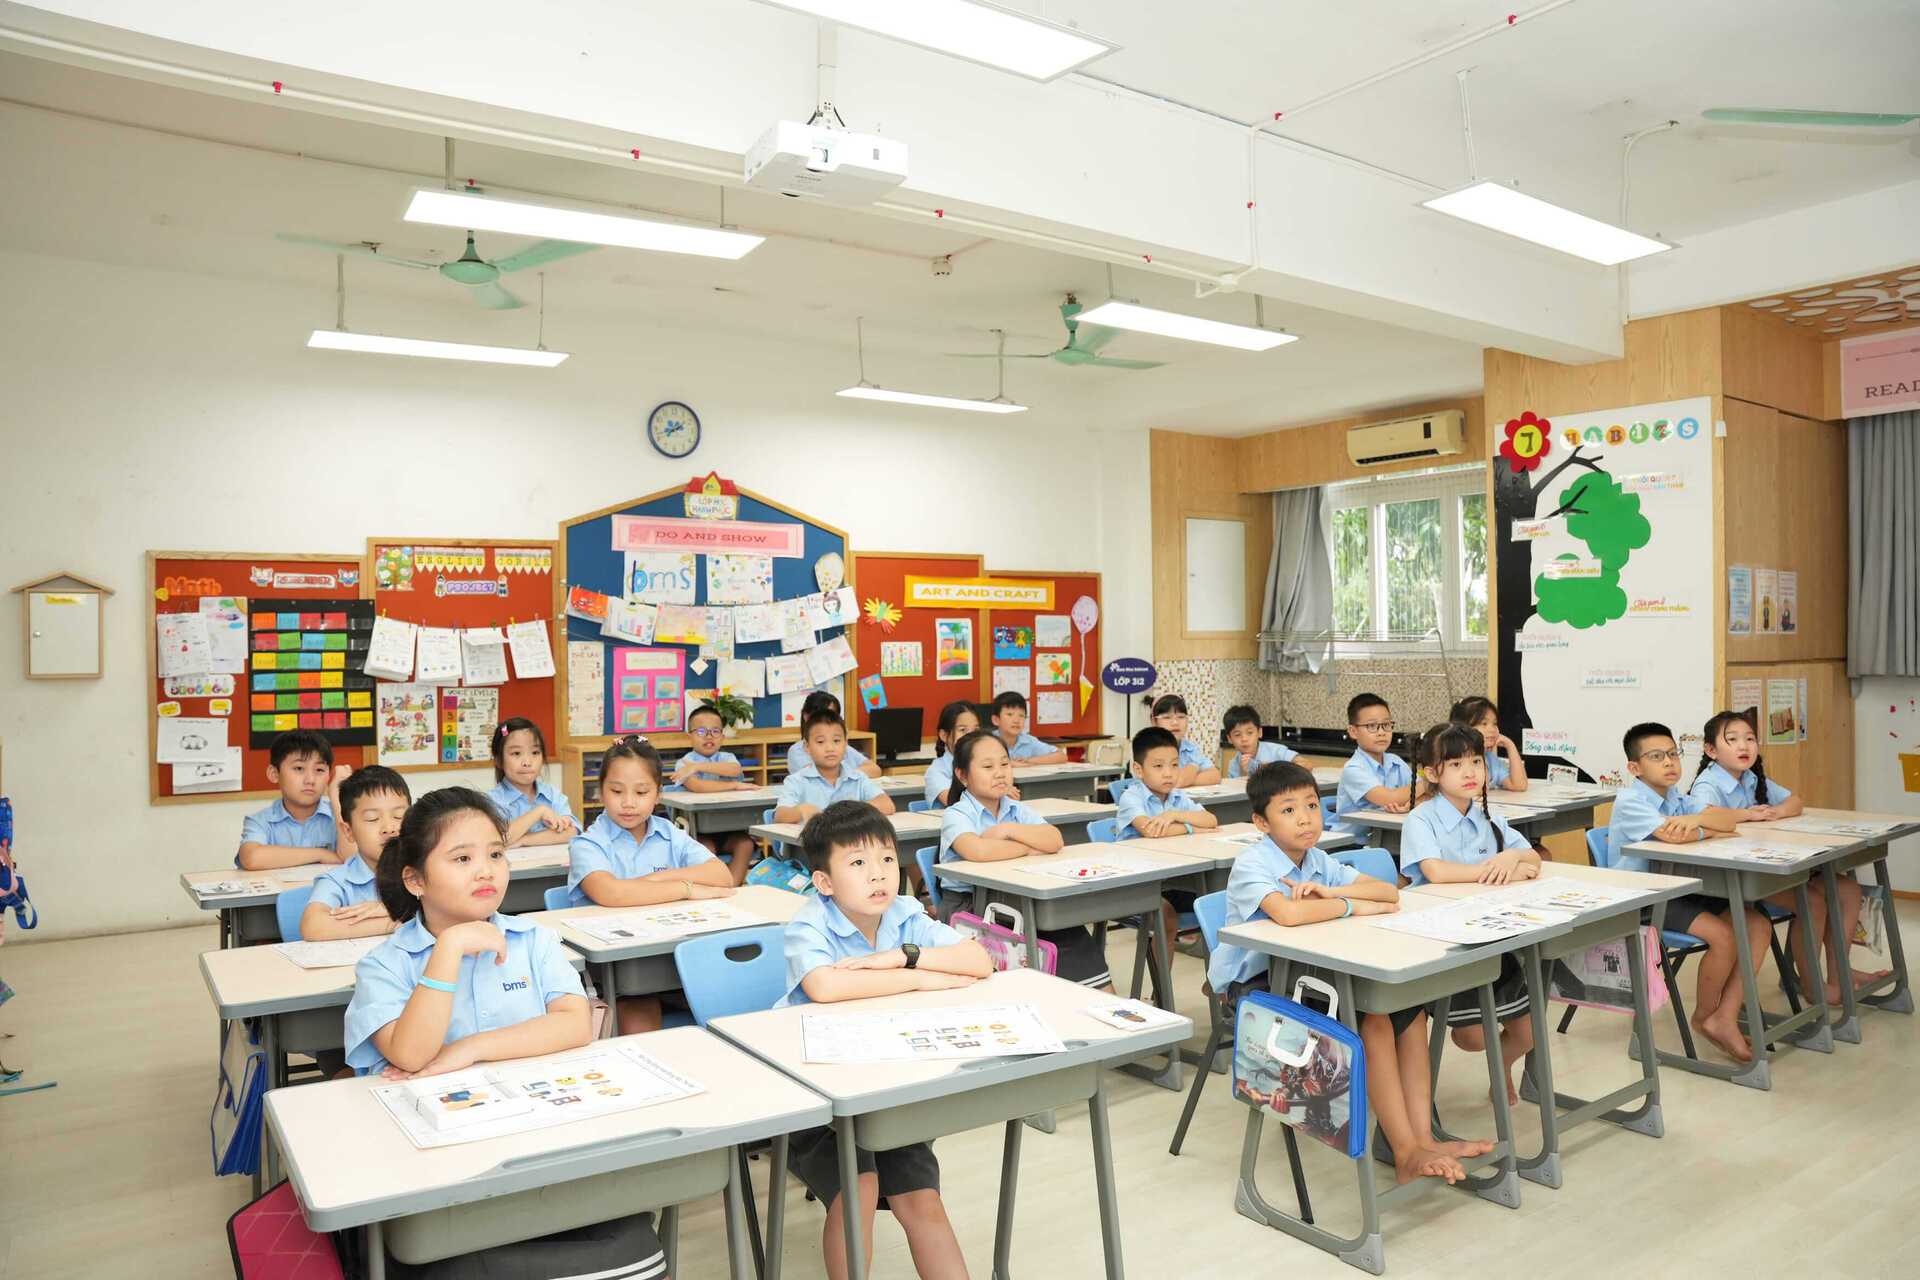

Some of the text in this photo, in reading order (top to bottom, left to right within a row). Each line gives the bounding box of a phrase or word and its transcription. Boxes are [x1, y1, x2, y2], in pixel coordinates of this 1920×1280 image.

[1520, 431, 1534, 453] 7
[655, 531, 767, 543] DO AND SHOW
[415, 556, 483, 566] ENGLISH
[164, 576, 222, 596] Math
[446, 582, 494, 593] PROJECT
[920, 587, 1041, 599] ART AND CRAFT
[502, 981, 527, 992] bms
